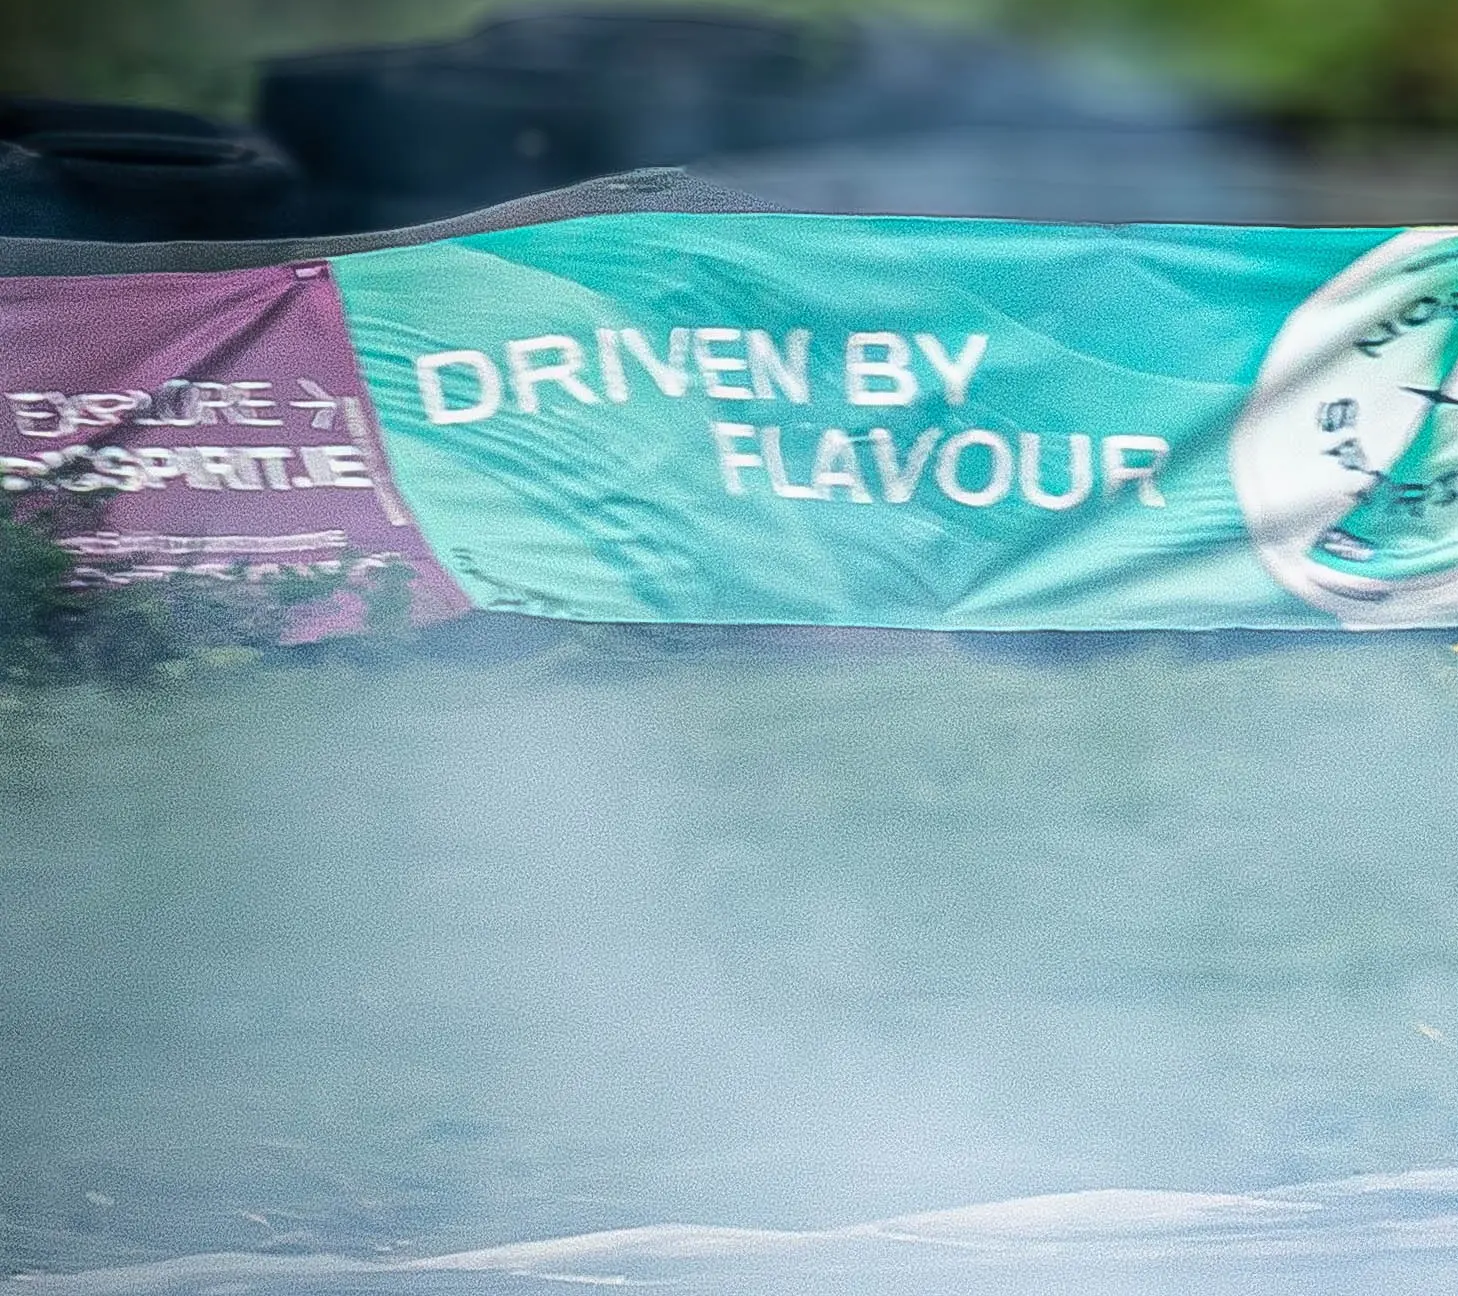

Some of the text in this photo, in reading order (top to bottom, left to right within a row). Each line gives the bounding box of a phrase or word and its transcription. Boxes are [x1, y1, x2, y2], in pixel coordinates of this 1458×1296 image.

[413, 326, 990, 425] DRIVEN BY
[710, 420, 1170, 512] FLAVOUR
